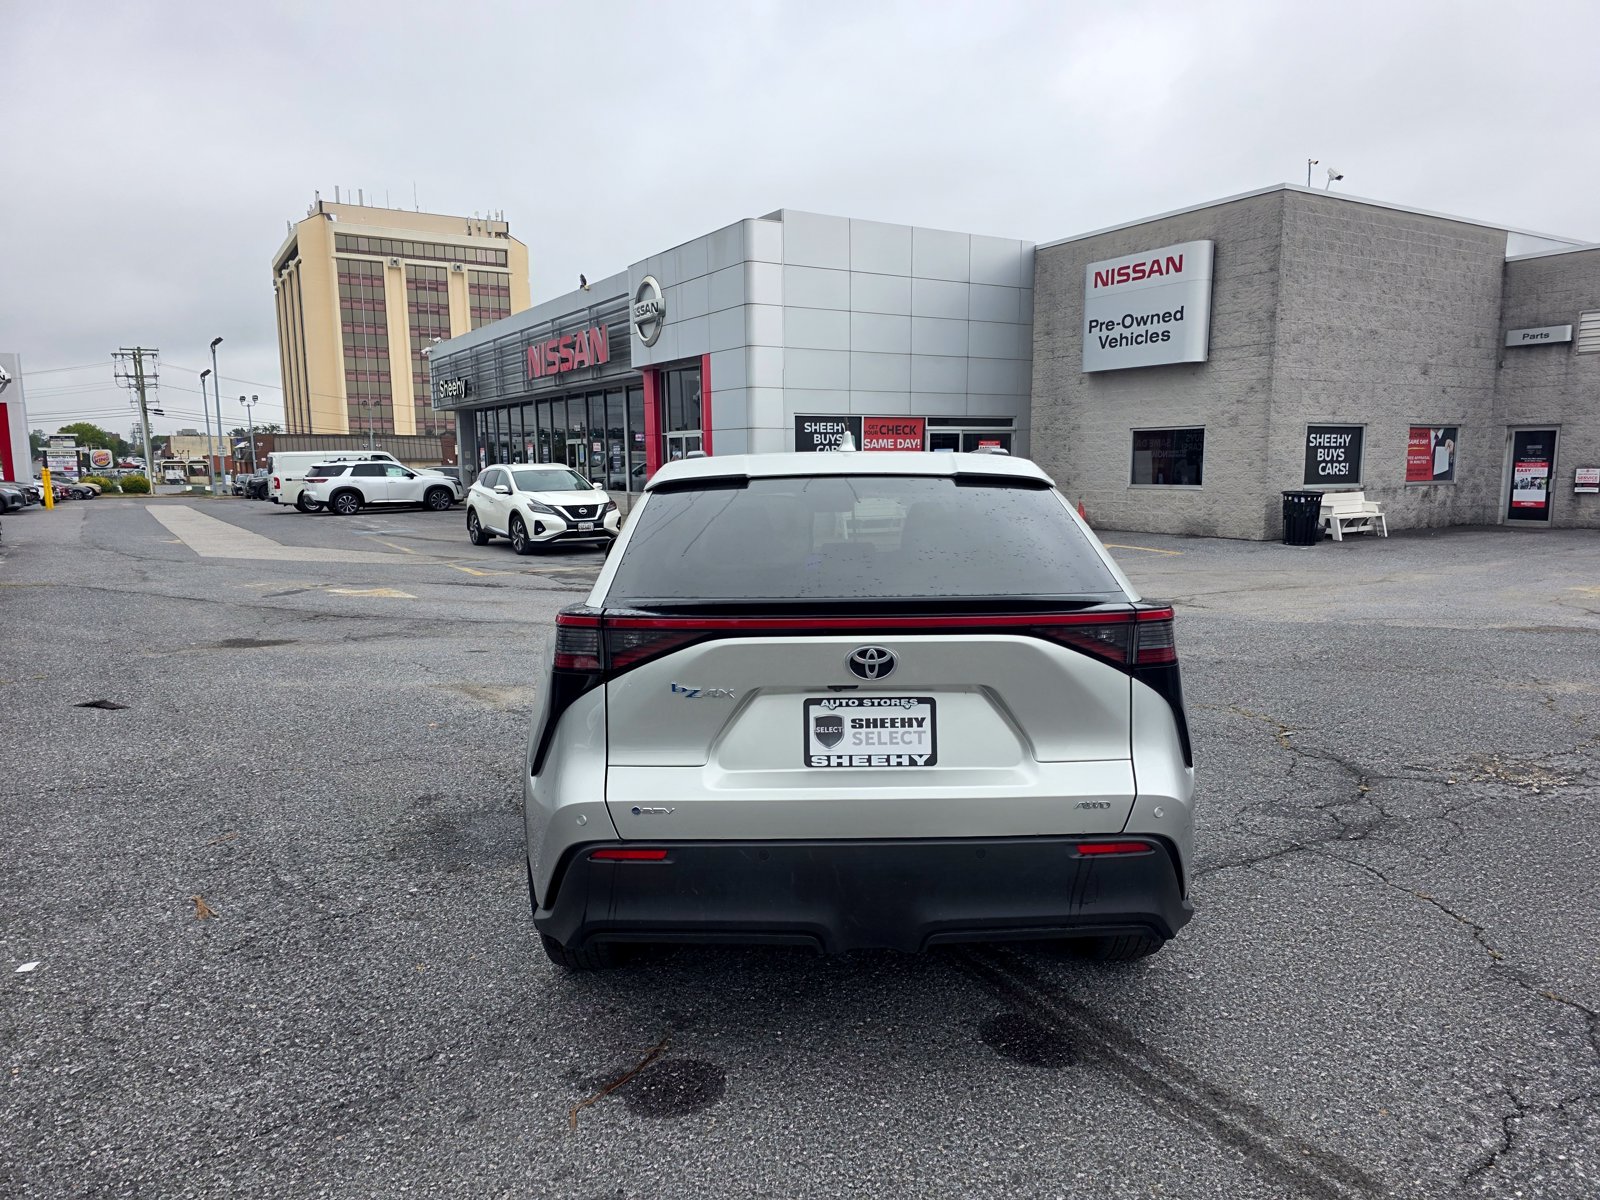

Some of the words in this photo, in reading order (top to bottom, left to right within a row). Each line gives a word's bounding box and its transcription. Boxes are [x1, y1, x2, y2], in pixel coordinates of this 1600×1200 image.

[1094, 254, 1184, 289] NISSAN
[1088, 305, 1184, 334] Pre-Owned
[1098, 330, 1171, 350] Vehicles
[1522, 333, 1550, 341] Parts
[527, 323, 610, 380] NISSAN
[439, 377, 466, 399] Sheehy
[880, 424, 917, 436] CHECK
[864, 439, 895, 449] SAME
[896, 439, 921, 449] DAY!
[1309, 434, 1352, 447] SHEEHY
[1317, 449, 1345, 461] BUYS
[1318, 463, 1349, 475] CARS!
[820, 699, 859, 707] AUTO
[862, 699, 919, 707] STORES
[850, 717, 927, 729] SHEEHY
[852, 731, 927, 746] SELECT
[811, 755, 932, 767] SHEEHY
